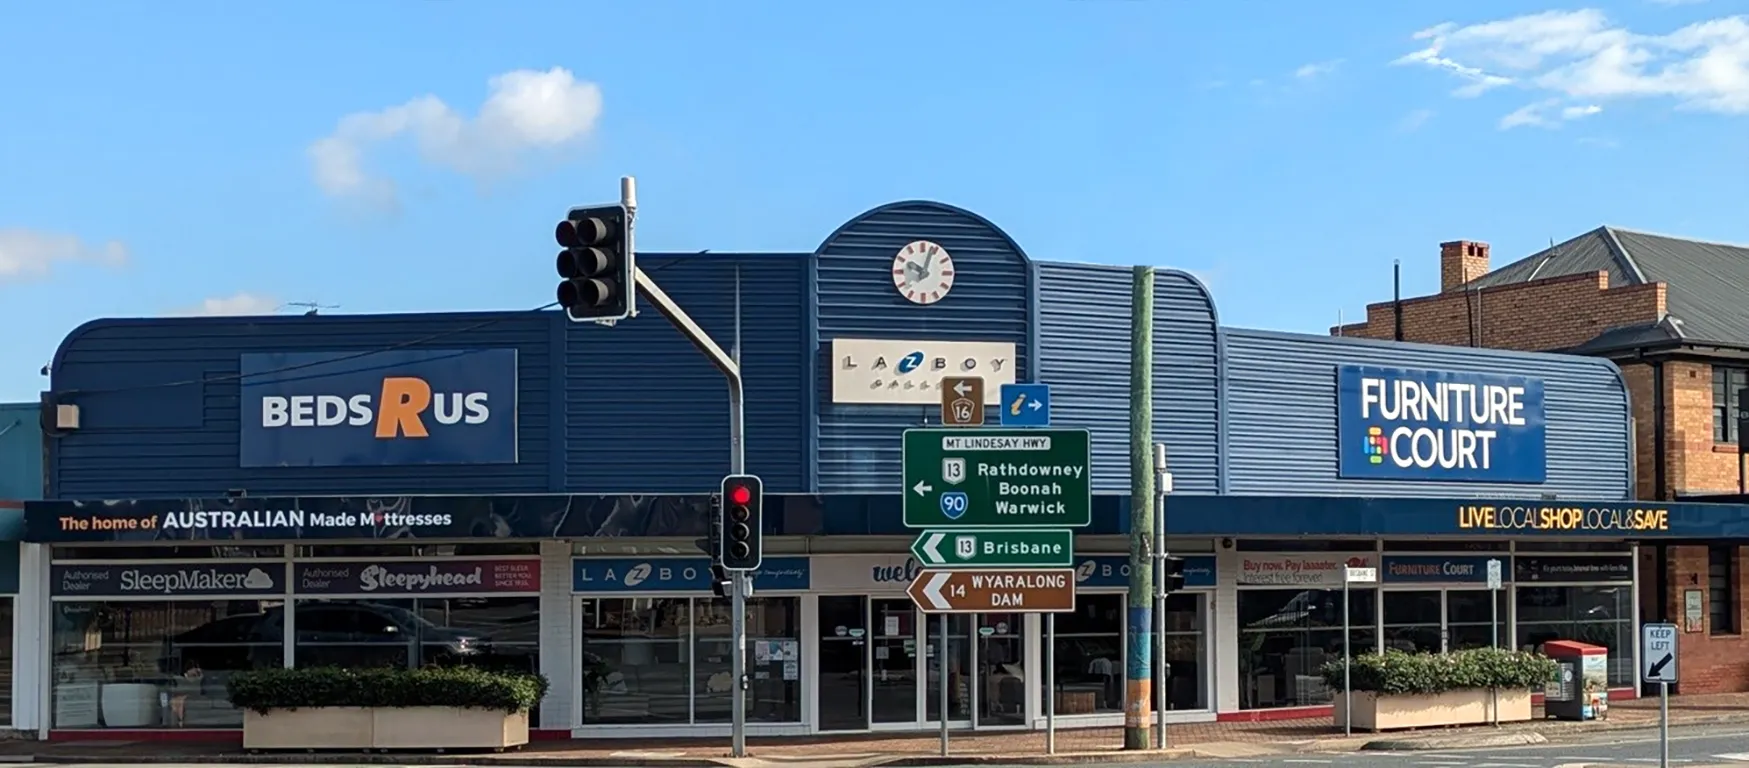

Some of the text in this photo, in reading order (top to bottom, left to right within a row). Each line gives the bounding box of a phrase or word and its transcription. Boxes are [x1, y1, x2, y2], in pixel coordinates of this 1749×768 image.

[870, 379, 943, 390] GALL
[1361, 378, 1526, 426] FURNITURE
[955, 405, 970, 420] 16
[946, 438, 1047, 449] MT LINDESAY HWY
[1390, 426, 1497, 470] COURT
[946, 463, 961, 478] 13
[978, 463, 1083, 479] Rathdowney
[999, 482, 1062, 496] Boonah
[943, 496, 964, 511] 90
[996, 501, 1066, 514] Warwick
[59, 510, 452, 530] The home of AUSTRALIAN Made Mttresses
[959, 540, 1062, 555] 13 Brisbane
[1243, 560, 1261, 573] Buy
[1285, 560, 1301, 573] Pay
[120, 569, 247, 594] SleepMaker
[360, 564, 482, 591] Sleepyhead
[582, 563, 715, 587] LAZBO
[972, 575, 1066, 589] WYARALONG
[62, 581, 92, 591] Dealer
[302, 579, 331, 589] Dealer
[950, 584, 966, 598] 14
[991, 593, 1024, 607] DAM
[1650, 629, 1671, 639] KEEP
[1651, 641, 1670, 650] LEFT
